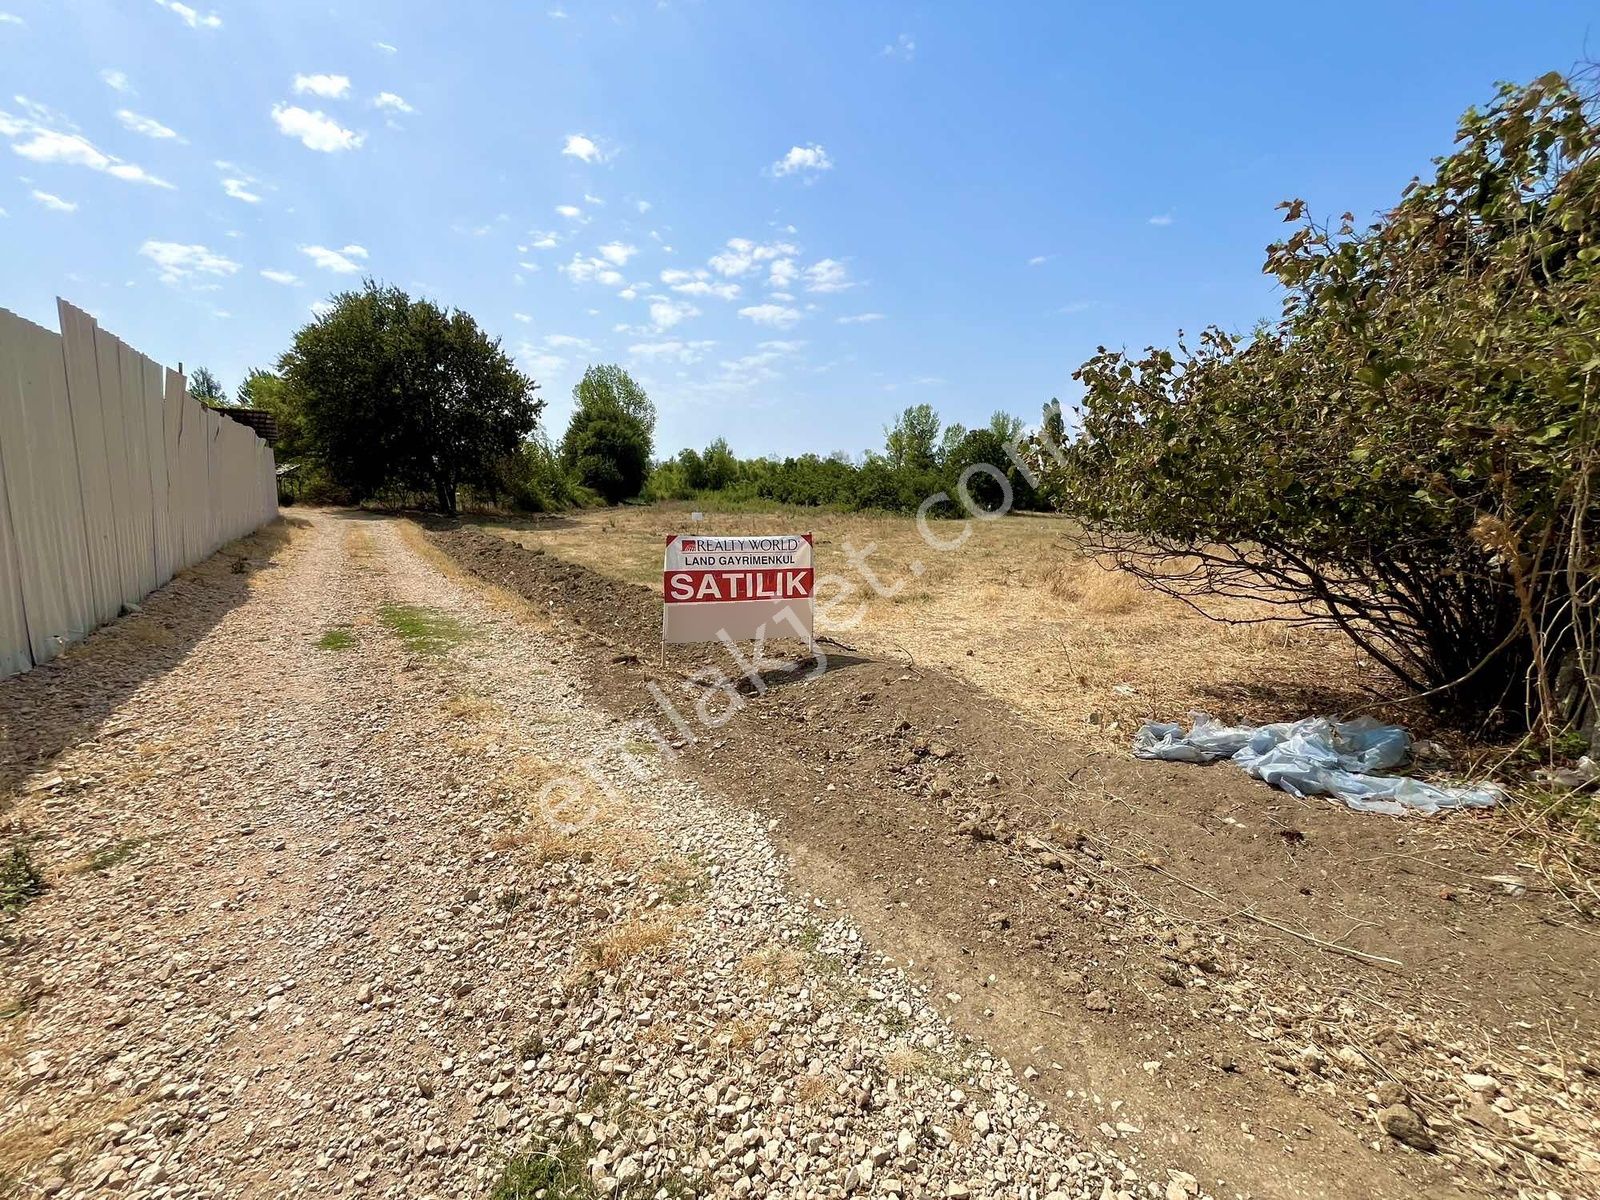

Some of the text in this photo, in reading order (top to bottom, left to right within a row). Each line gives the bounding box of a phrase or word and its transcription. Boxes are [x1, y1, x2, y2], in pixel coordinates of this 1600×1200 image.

[697, 539, 798, 552] REALTY WORLD
[685, 554, 795, 566] LAND GAYRİMENKUL
[670, 571, 808, 600] SATILIK
